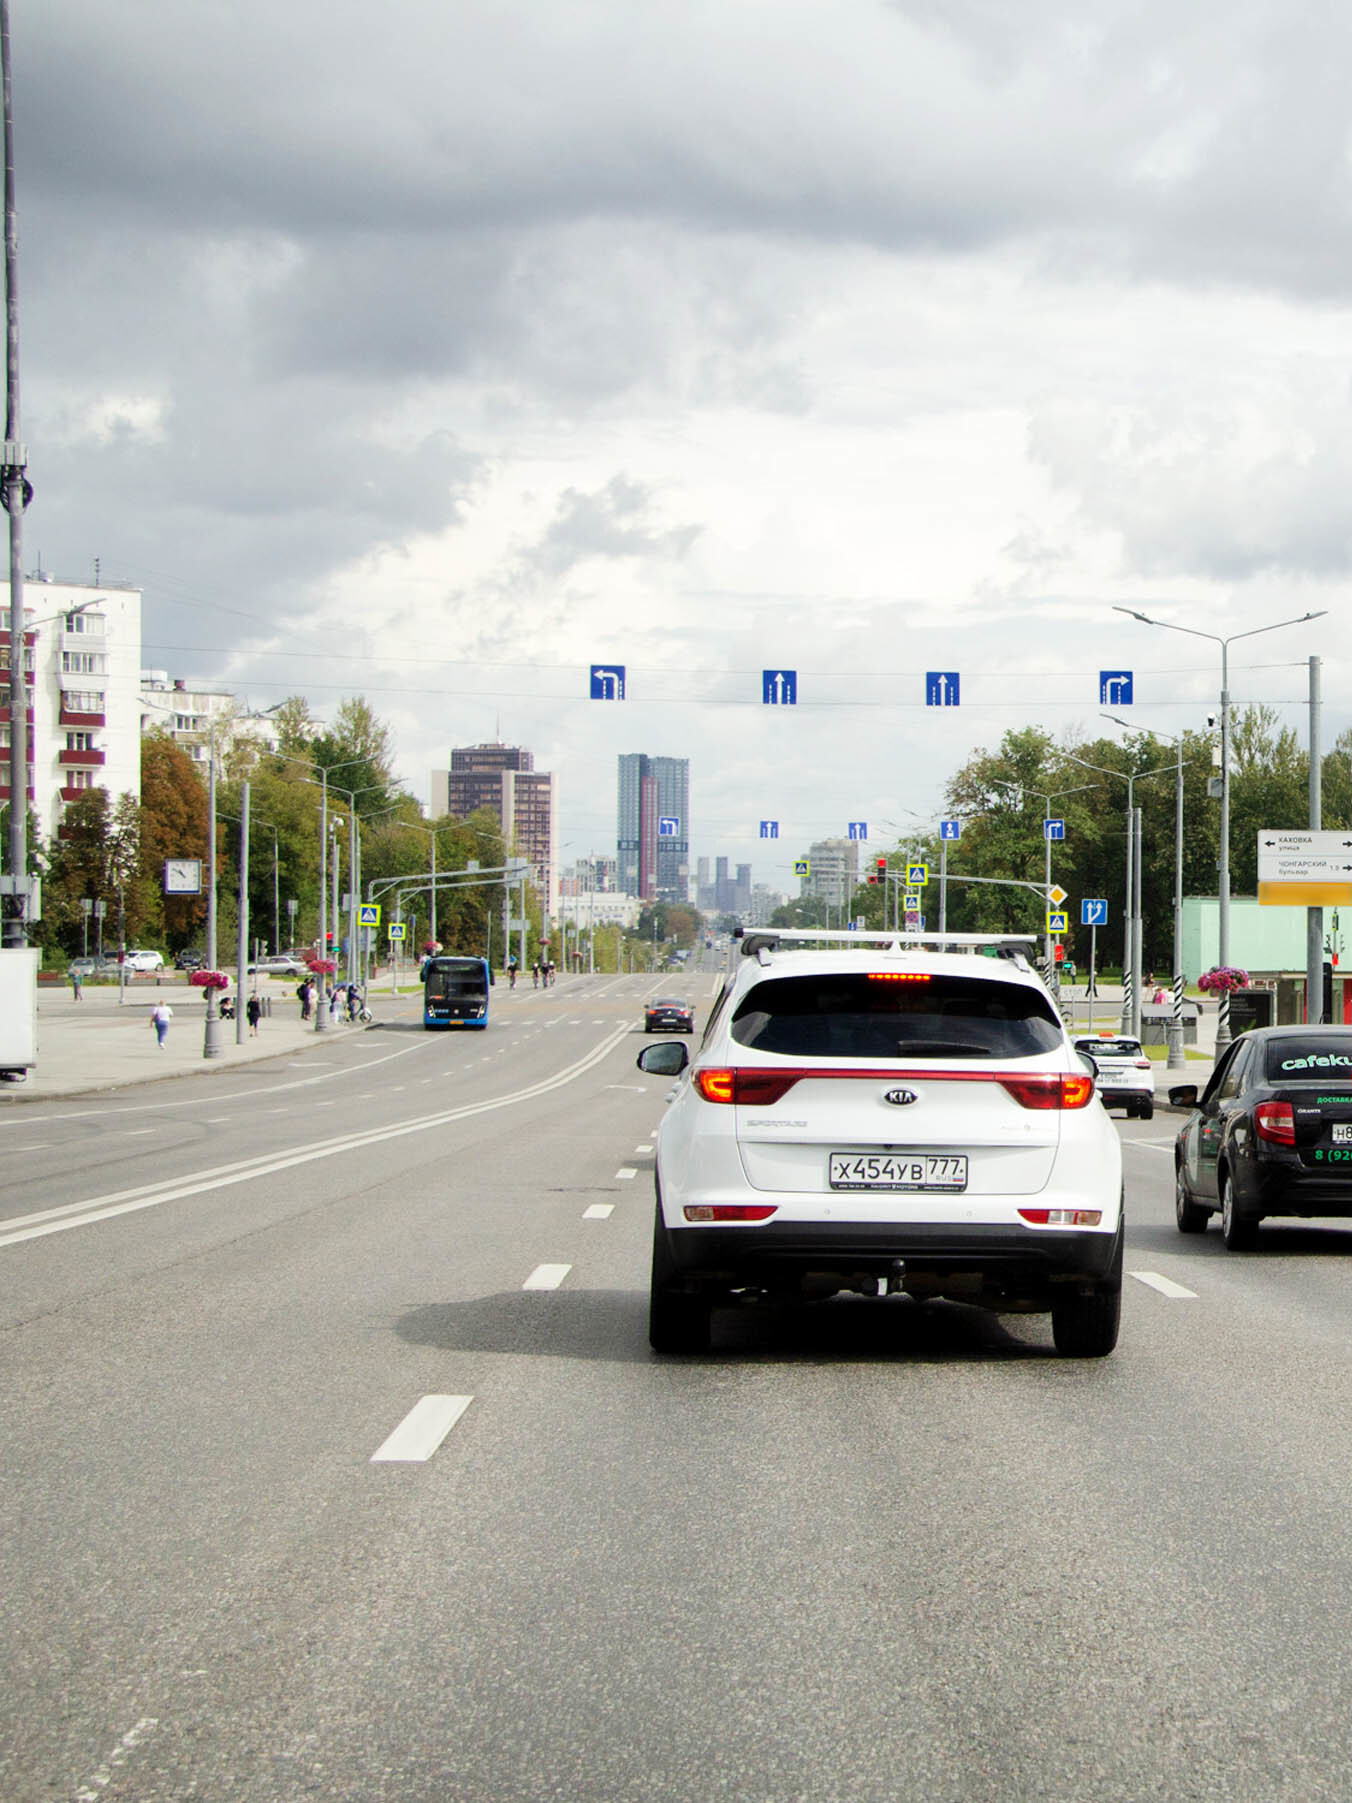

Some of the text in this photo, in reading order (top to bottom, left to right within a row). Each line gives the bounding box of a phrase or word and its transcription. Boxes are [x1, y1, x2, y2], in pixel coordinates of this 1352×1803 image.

[1278, 836, 1312, 844] КАХОВКА
[1278, 860, 1327, 868] ЧОНГАРСКИЙ
[889, 1091, 913, 1102] KIA
[1315, 1151, 1323, 1160] 8
[928, 1159, 960, 1175] 777
